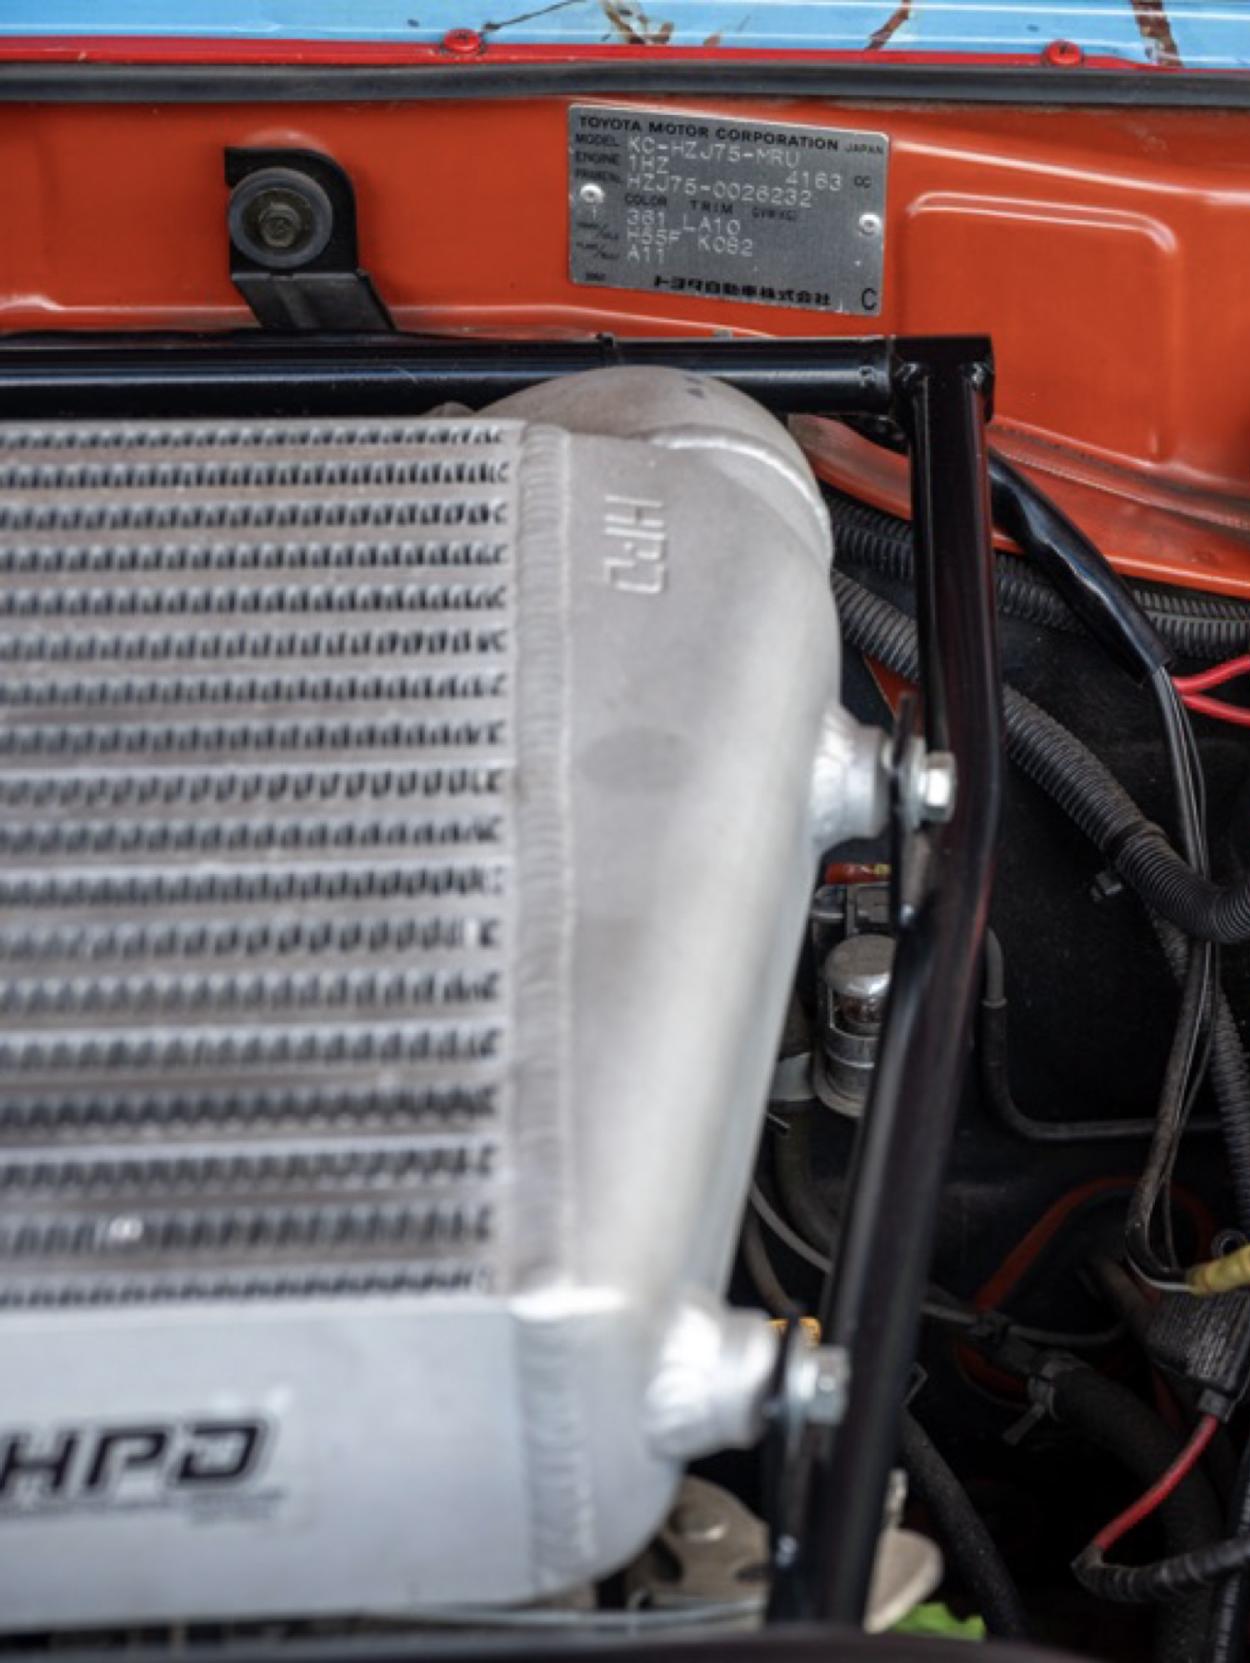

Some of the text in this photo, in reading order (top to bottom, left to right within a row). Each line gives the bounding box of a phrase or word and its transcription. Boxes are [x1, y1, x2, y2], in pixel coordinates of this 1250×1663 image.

[580, 116, 641, 132] TOYOTA
[649, 121, 709, 138] MOTOR
[715, 128, 838, 150] CORPORATION
[575, 133, 800, 168] MODEL KC-HZJ75-MRU
[628, 154, 669, 174] 1HZ
[785, 170, 841, 191] 4163
[690, 199, 733, 214] TRIM
[861, 287, 878, 311] C
[0, 1420, 264, 1492] HPD
